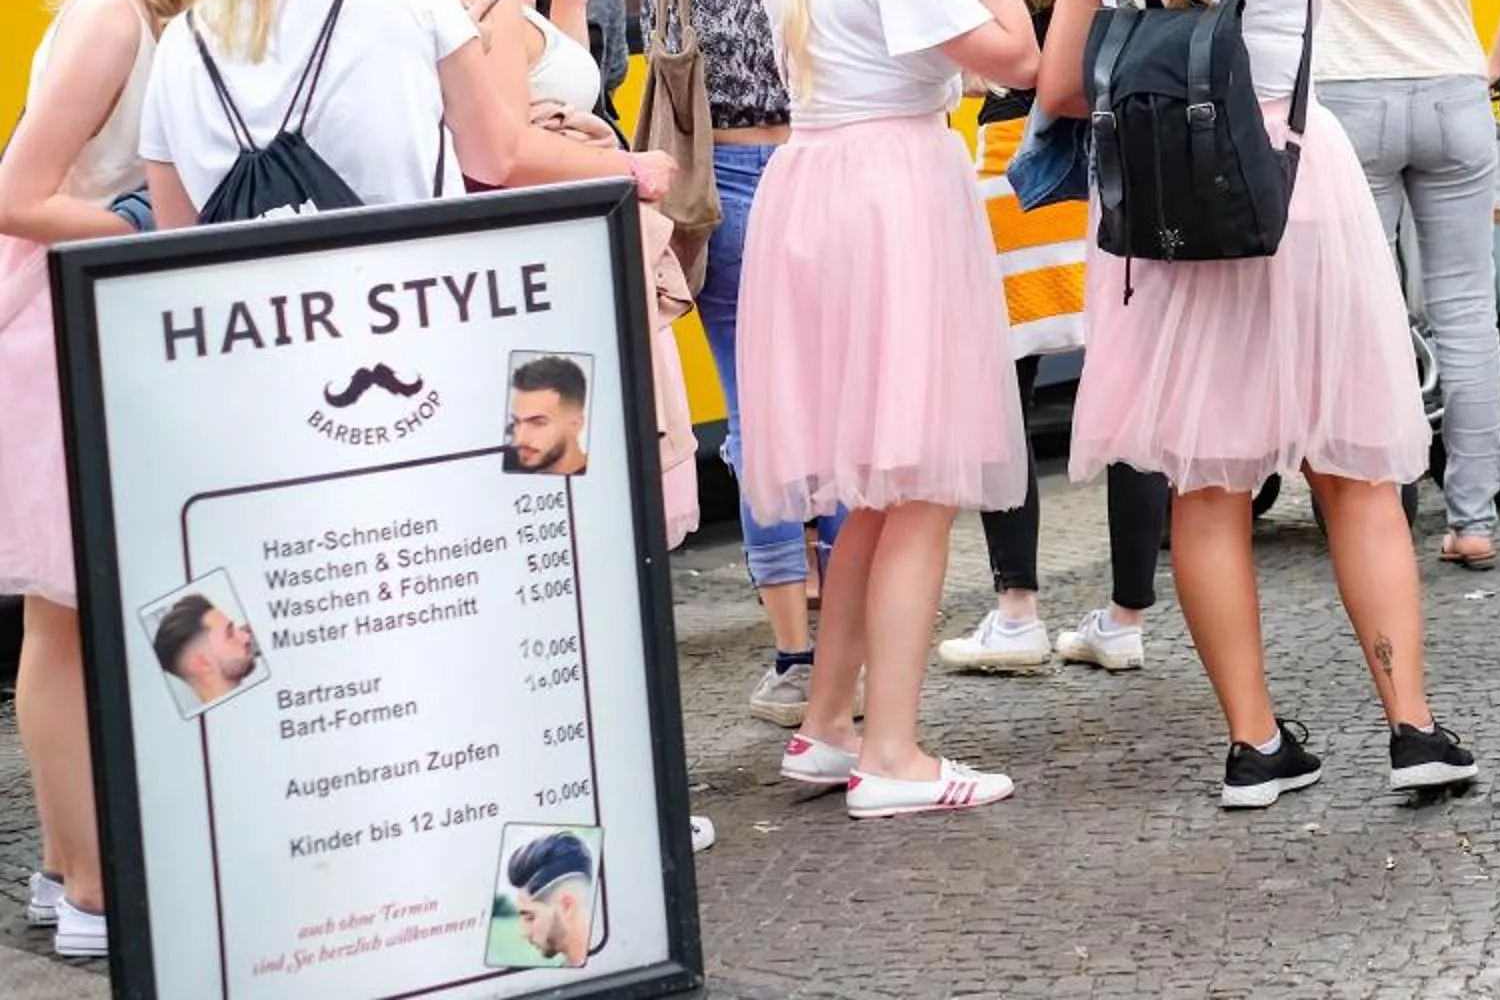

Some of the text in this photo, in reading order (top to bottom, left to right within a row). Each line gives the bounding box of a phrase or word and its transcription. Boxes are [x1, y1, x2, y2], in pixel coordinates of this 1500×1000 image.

[161, 263, 551, 361] HAIR STYLE
[306, 389, 444, 446] BARBER SHOP
[263, 491, 565, 560] Haar-Schneiden 12,00€
[265, 520, 567, 590] Waschen & Schneiden 15,00€
[267, 549, 570, 620] Waschen & Föhnen 5,00€
[271, 621, 348, 650] Muster
[355, 598, 479, 636] Haarschnitt
[276, 677, 382, 710] Bartrasur
[280, 700, 418, 740] Bart-Formen
[285, 722, 585, 799] Augenbraun Zupfen 5,00€
[289, 827, 363, 859] Kinder
[370, 820, 402, 842] bis
[410, 812, 434, 834] 12
[439, 801, 500, 828] Jahre
[298, 896, 438, 939] auch ohne Termin
[286, 951, 315, 975] Sie
[318, 934, 382, 962] herzlich
